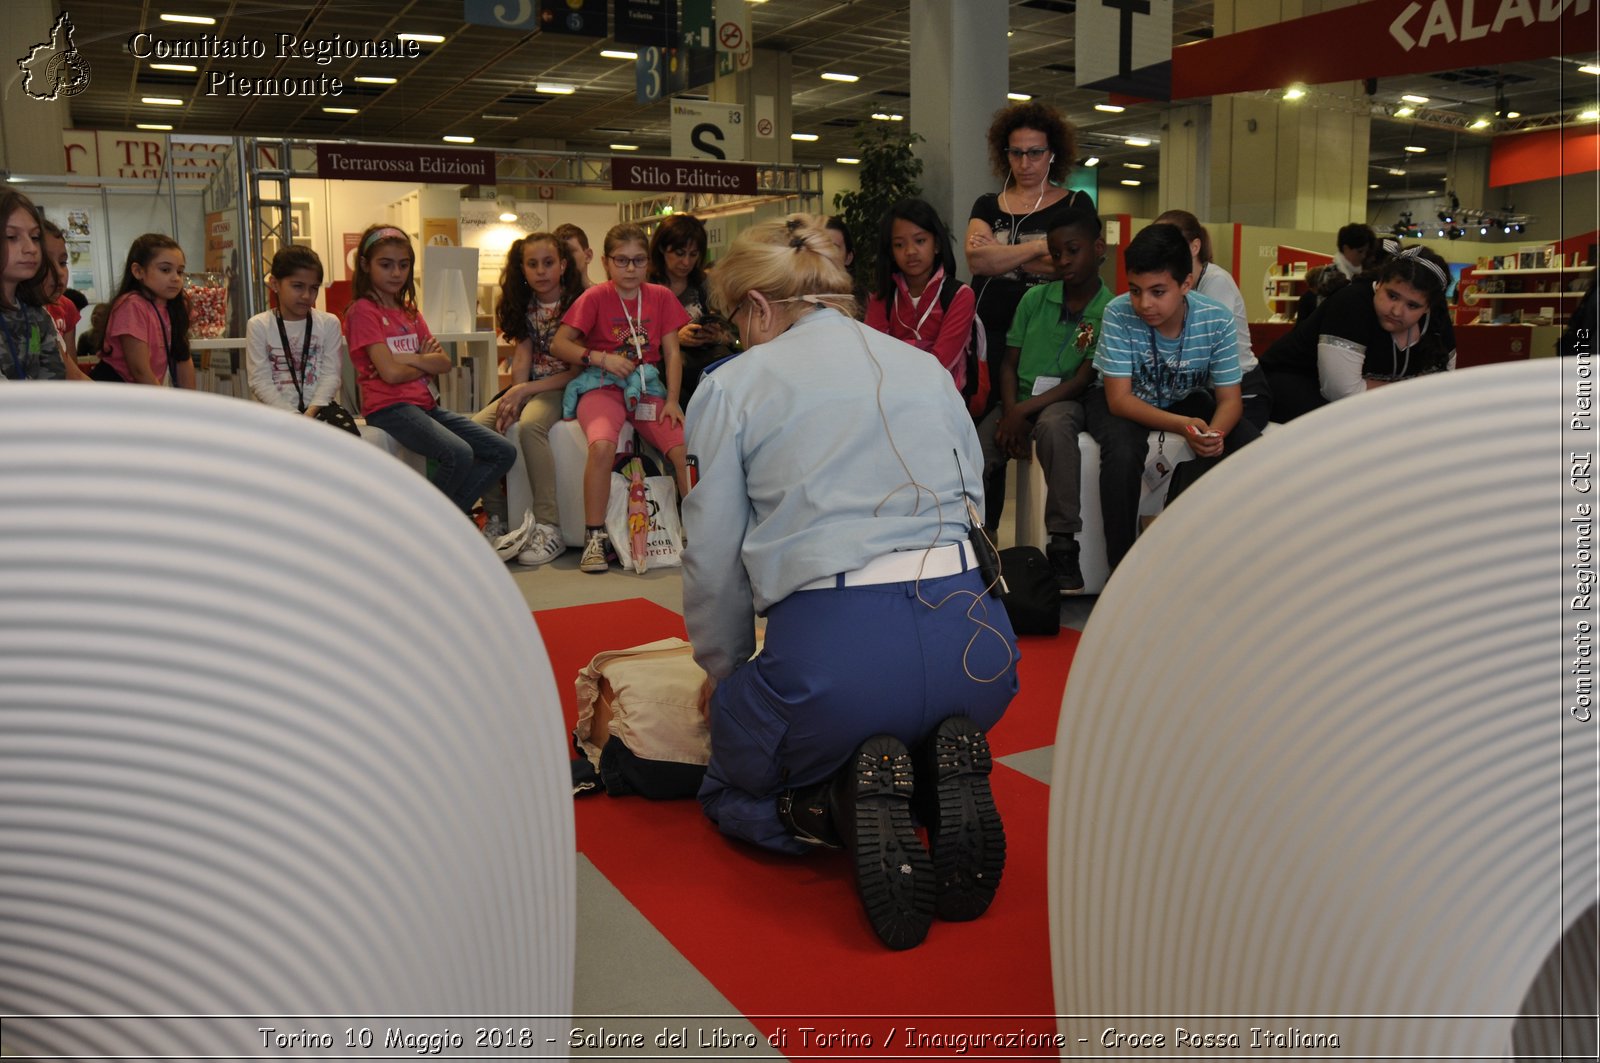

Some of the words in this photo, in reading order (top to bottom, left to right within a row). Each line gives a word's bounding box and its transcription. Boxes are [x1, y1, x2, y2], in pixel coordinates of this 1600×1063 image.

[1102, 0, 1151, 78] T
[645, 46, 661, 98] 3
[733, 111, 741, 124] 3
[328, 153, 414, 173] Terrarossa
[419, 156, 486, 176] Edizioni
[630, 165, 671, 185] Stilo
[676, 168, 740, 188] Editrice
[1258, 245, 1277, 257] REG
